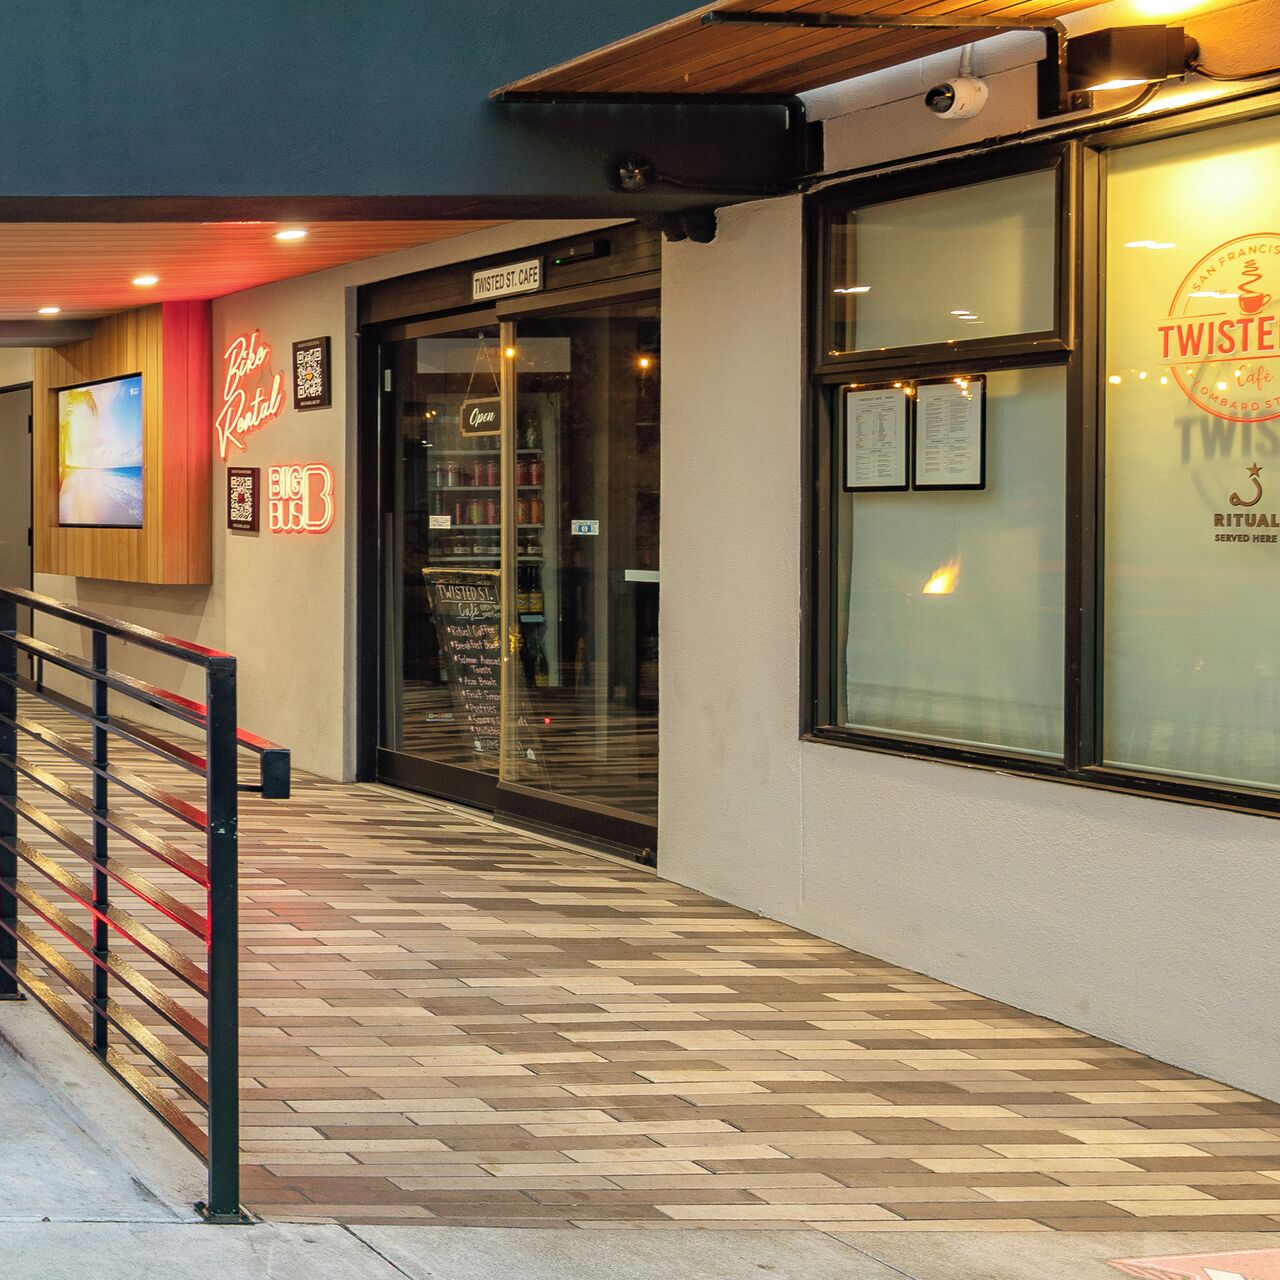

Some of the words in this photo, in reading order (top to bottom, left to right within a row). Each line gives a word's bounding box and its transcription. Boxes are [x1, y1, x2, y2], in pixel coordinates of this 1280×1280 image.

[474, 274, 505, 295] TWISTED
[506, 270, 517, 288] ST.
[518, 266, 538, 285] CAFE
[1192, 265, 1217, 292] SAN
[1158, 316, 1280, 359] TWISTE
[224, 332, 270, 402] Bike
[1192, 376, 1260, 411] LOMBARD
[215, 373, 283, 458] Rental
[469, 407, 495, 427] Open
[268, 465, 303, 500] BIG
[269, 500, 303, 530] BUS
[1213, 513, 1280, 528] RITUAL
[1214, 533, 1250, 543] SERVED
[1252, 534, 1278, 543] HERE
[436, 584, 477, 601] TWISTED
[479, 586, 494, 601] ST.
[480, 655, 501, 666] Avocad
